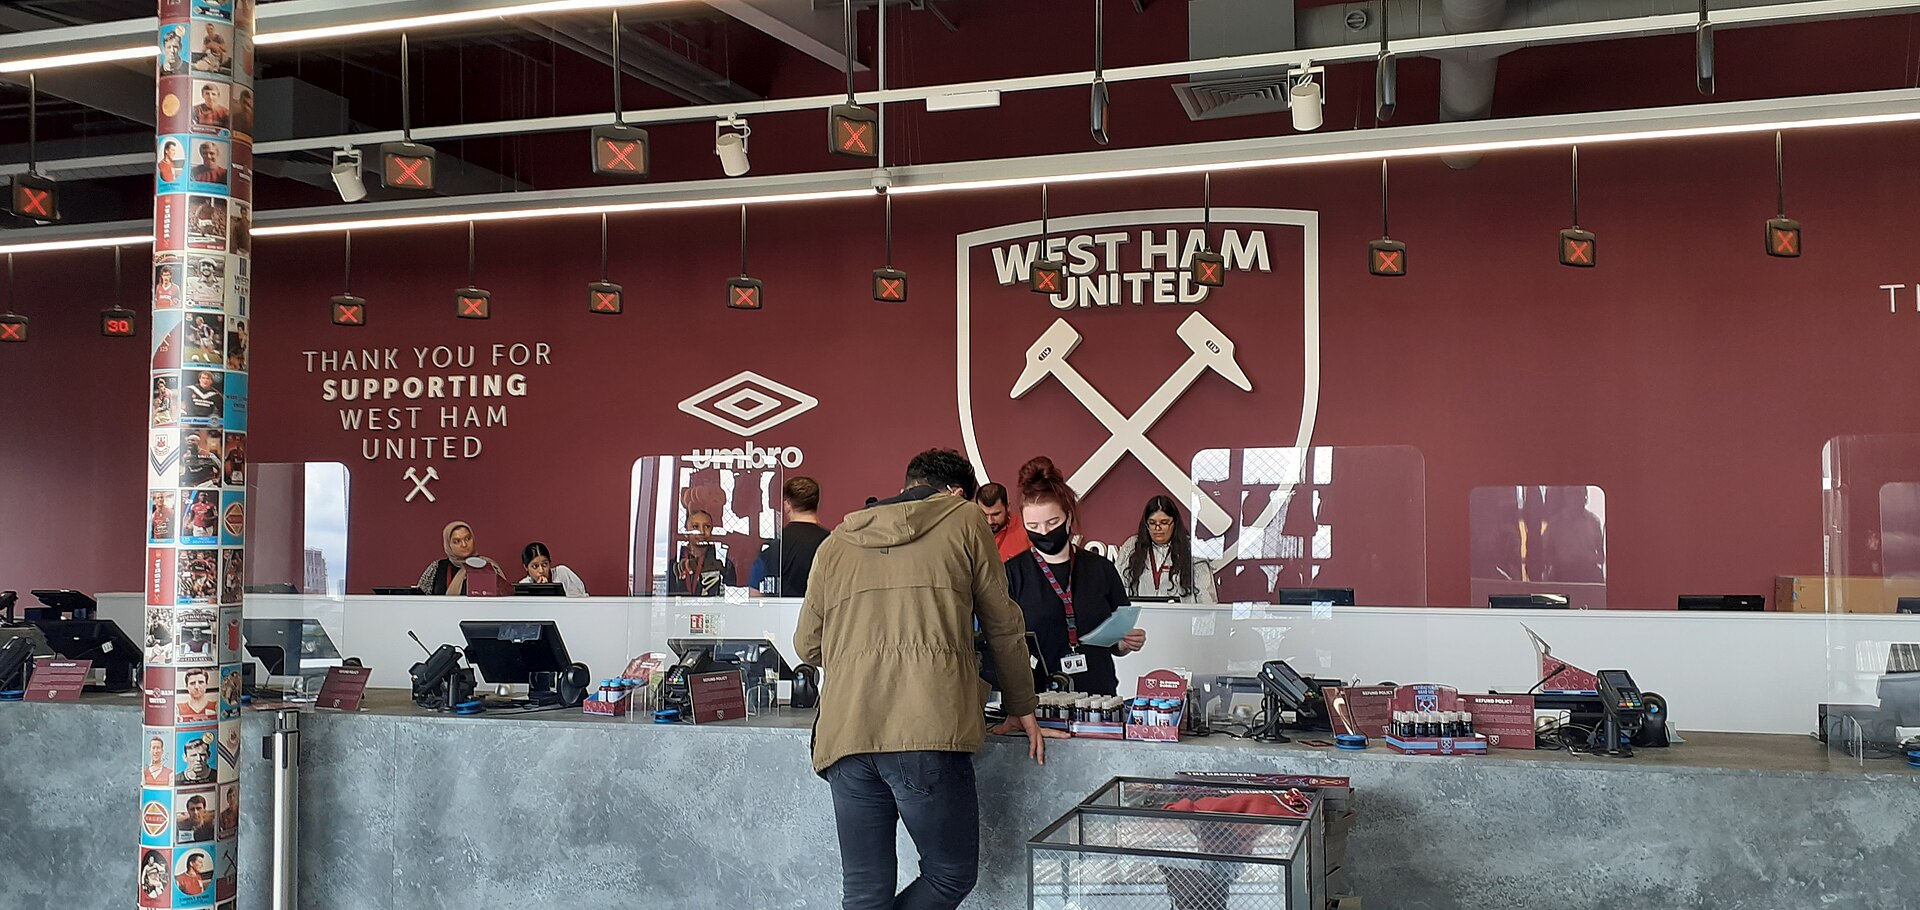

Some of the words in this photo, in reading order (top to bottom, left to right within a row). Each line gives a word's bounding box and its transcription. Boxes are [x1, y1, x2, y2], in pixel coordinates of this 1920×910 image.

[991, 231, 1129, 286] WEST
[1140, 228, 1272, 272] HAM
[1049, 271, 1210, 309] UNITED
[107, 319, 129, 333] 30
[302, 347, 399, 373] THANK
[413, 345, 475, 369] YOU
[491, 342, 552, 366] FOR
[321, 373, 528, 401] SUPPORTING
[339, 406, 423, 431] WEST
[440, 404, 508, 429] HAM
[361, 436, 483, 461] UNITED
[692, 441, 804, 469] umbro
